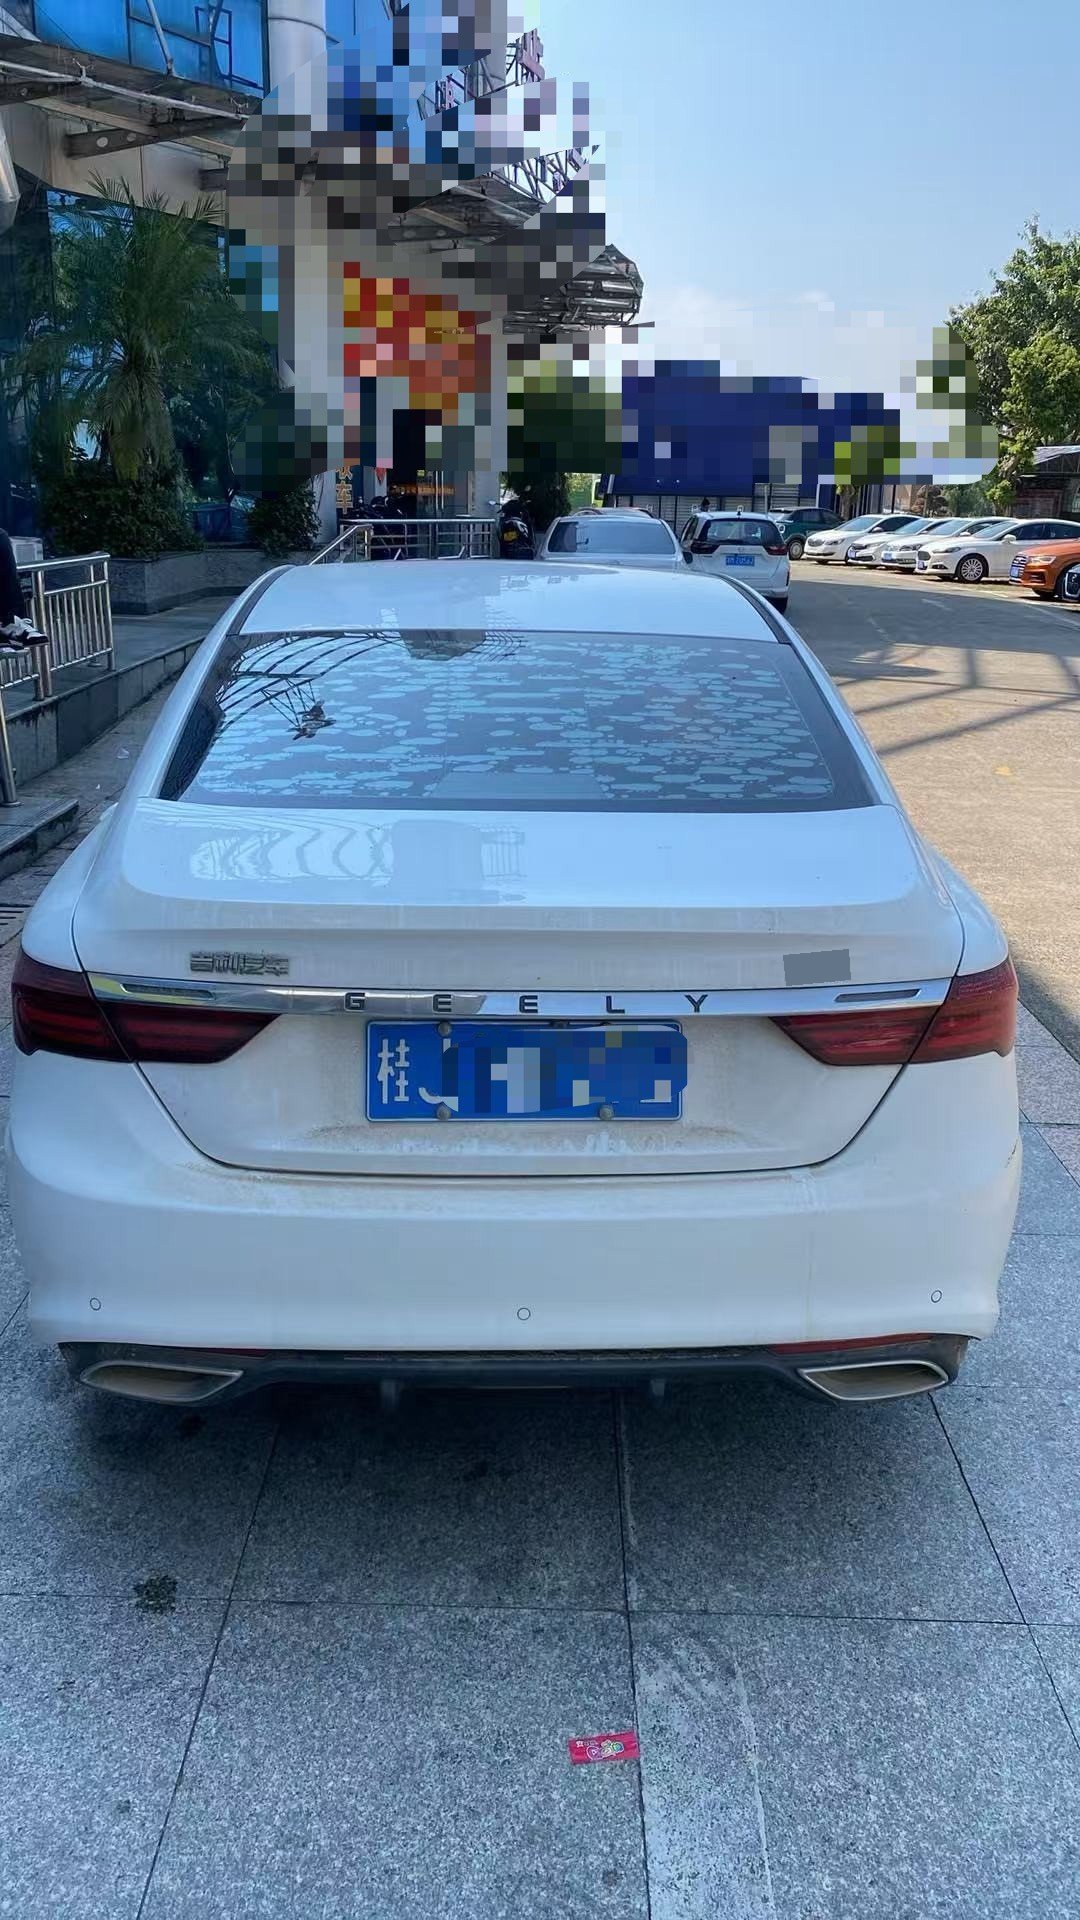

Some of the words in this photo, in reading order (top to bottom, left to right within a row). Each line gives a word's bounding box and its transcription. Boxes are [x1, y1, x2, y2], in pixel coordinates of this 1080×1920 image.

[190, 952, 290, 977] 吉利汽车
[344, 992, 708, 1014] GEELY
